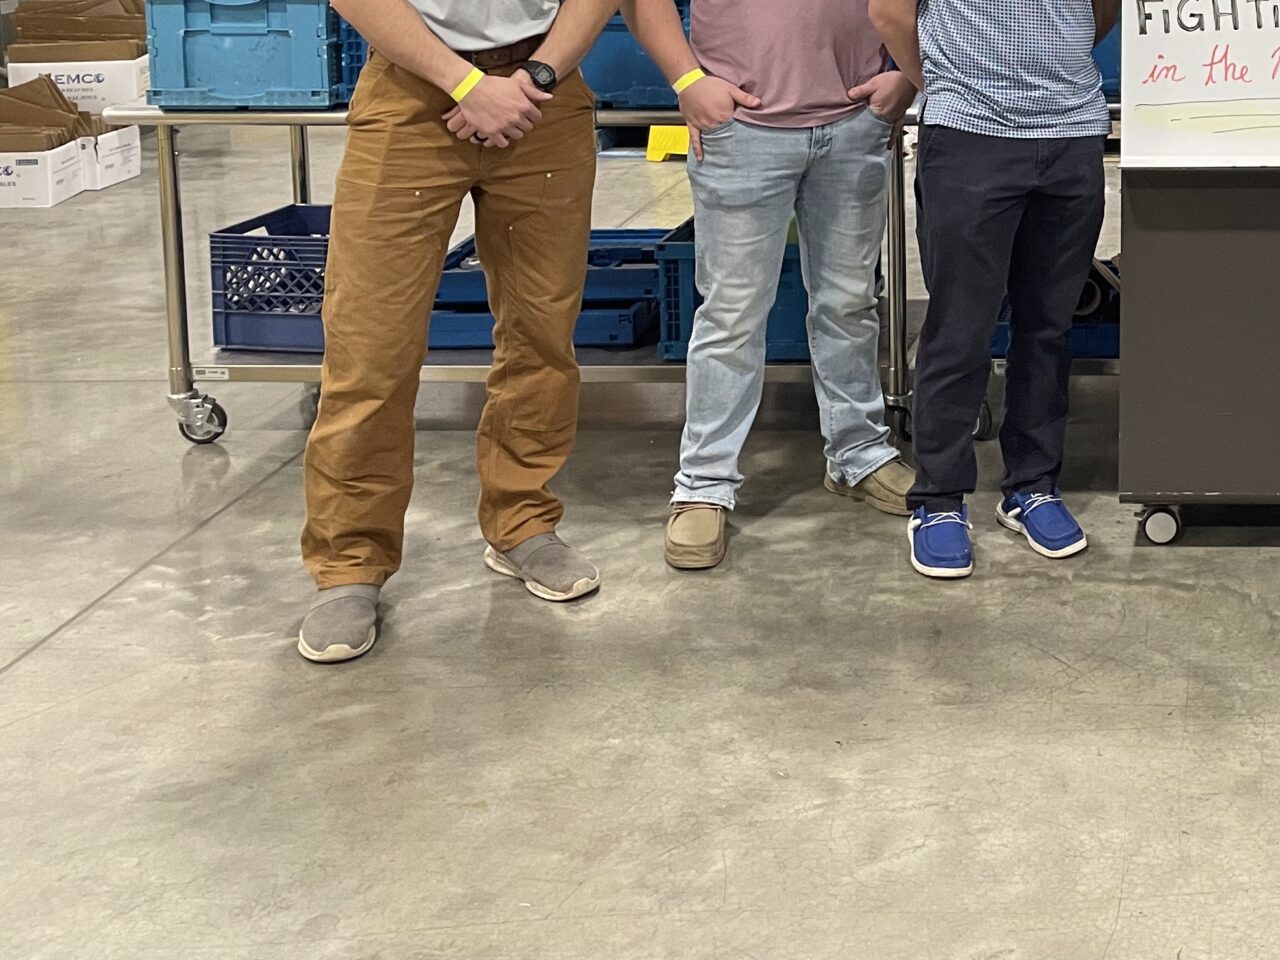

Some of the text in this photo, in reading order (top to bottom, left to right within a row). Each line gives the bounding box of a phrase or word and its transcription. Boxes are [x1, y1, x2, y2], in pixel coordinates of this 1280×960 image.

[54, 73, 105, 85] EMCO
[1142, 54, 1185, 85] in
[1202, 44, 1254, 87] the
